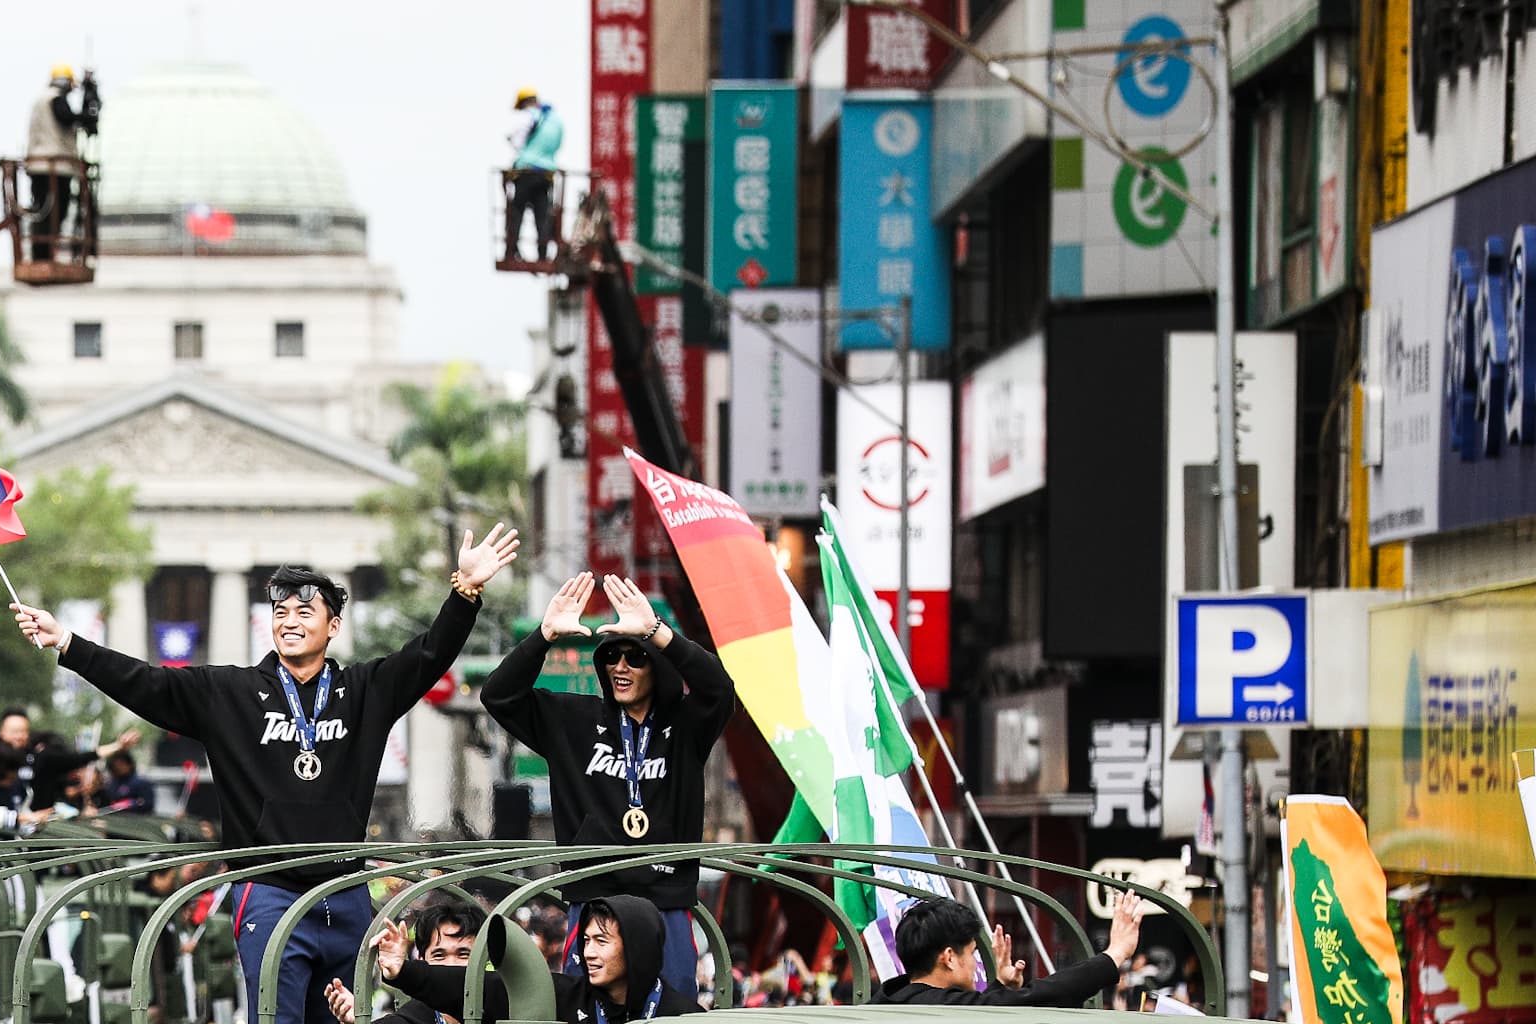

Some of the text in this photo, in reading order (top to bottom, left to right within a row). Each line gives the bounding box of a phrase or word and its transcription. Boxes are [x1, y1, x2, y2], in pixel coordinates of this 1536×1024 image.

[1195, 604, 1293, 718] P
[260, 711, 349, 745] Taian
[585, 742, 668, 781] Taian
